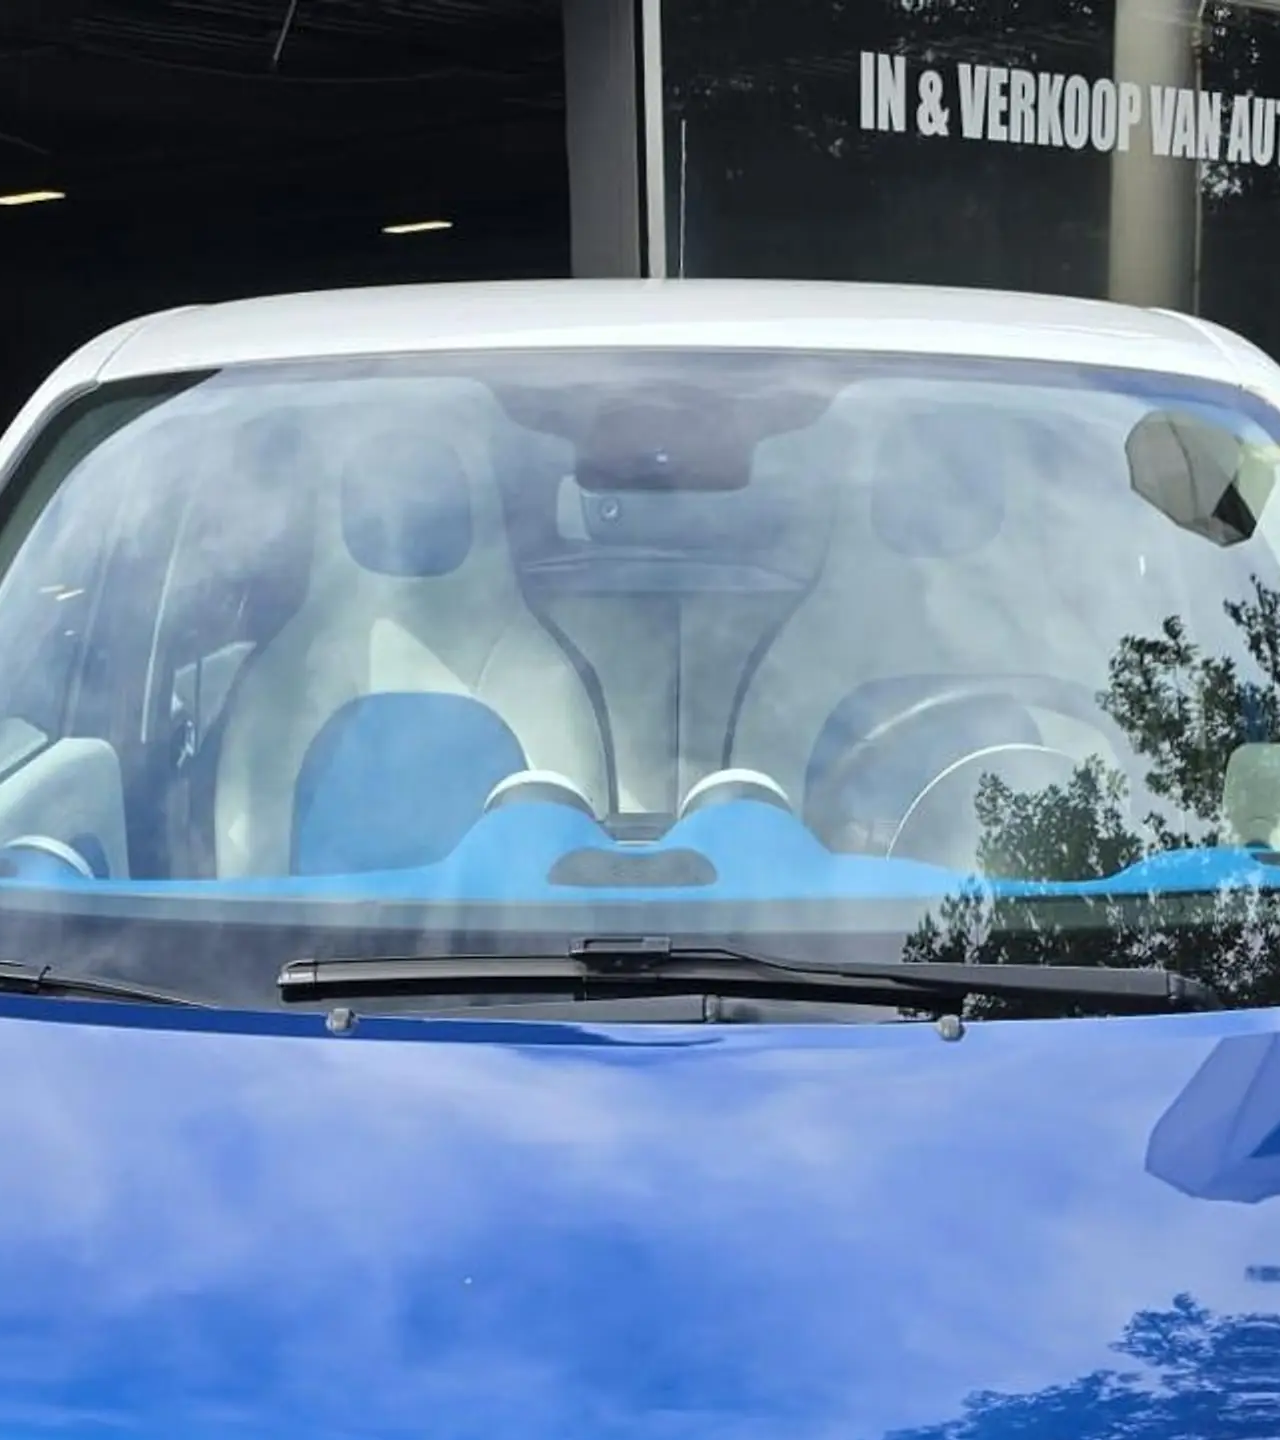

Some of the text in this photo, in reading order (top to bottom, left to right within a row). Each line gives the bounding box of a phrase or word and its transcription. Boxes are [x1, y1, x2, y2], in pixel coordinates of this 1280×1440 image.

[860, 51, 907, 132] IN
[917, 69, 950, 136] &
[958, 63, 1142, 153] VERKOOP
[1150, 84, 1222, 160] VAN
